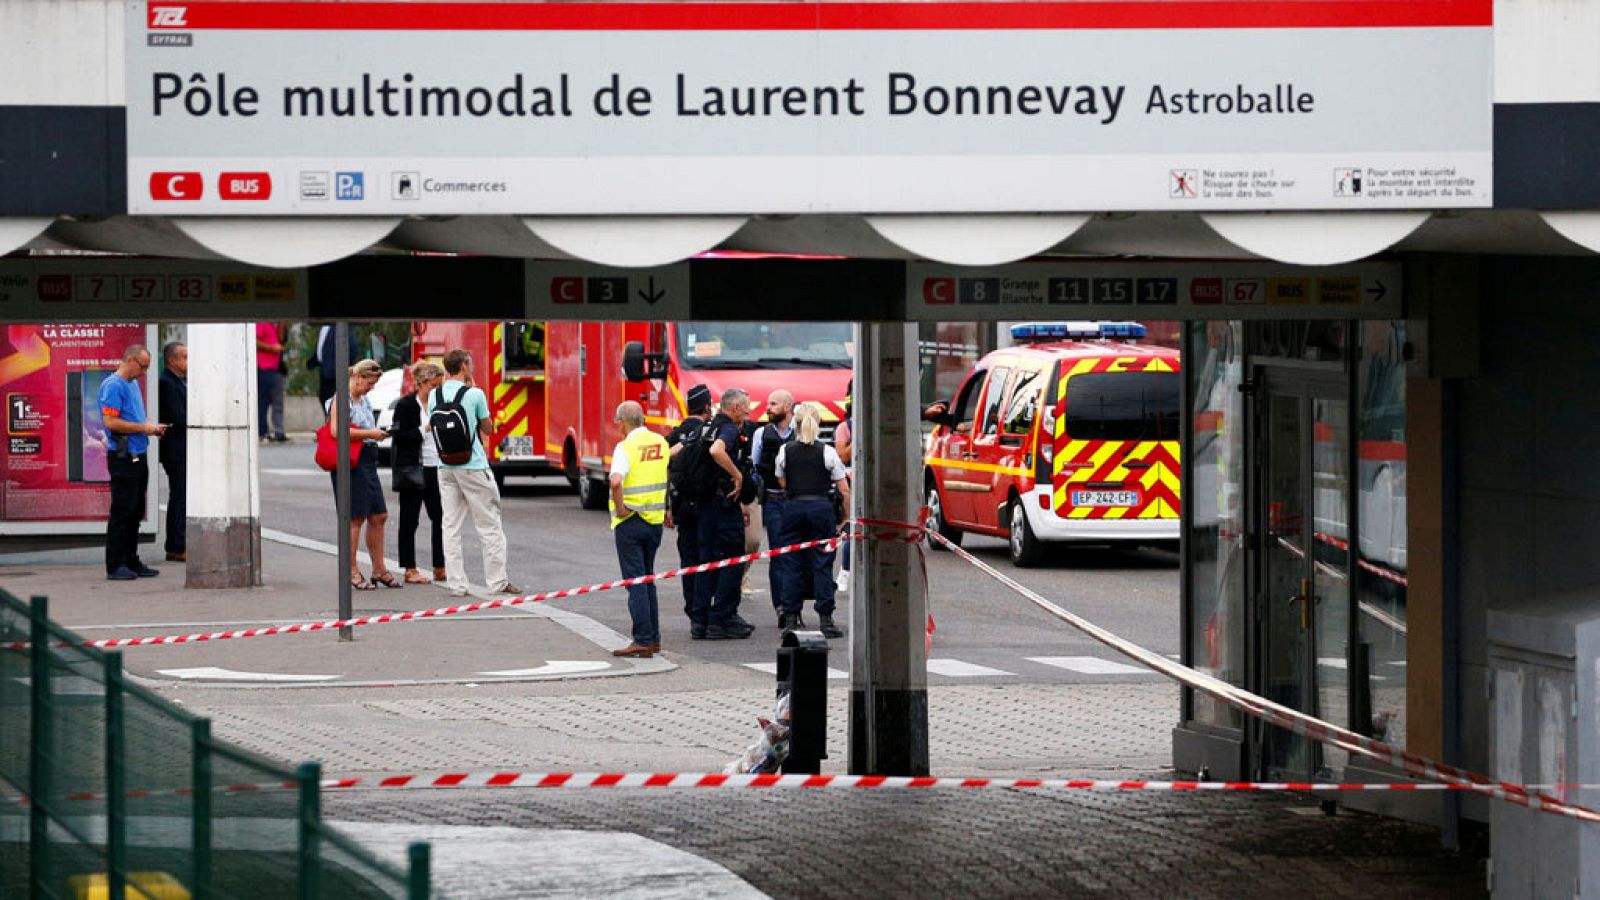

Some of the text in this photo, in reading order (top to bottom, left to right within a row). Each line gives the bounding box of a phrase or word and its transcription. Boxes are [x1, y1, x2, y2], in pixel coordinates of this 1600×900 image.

[152, 6, 188, 26] TCL
[152, 72, 1315, 126] Pôle multimodal de Laurent Bonnevay Astroballe
[1366, 167, 1389, 176] Pour
[167, 176, 185, 197] C
[230, 179, 260, 193] BUS
[423, 177, 507, 192] Commerces
[1203, 179, 1234, 189] Risque
[1237, 179, 1248, 188] de
[1251, 179, 1278, 188] chute
[1434, 177, 1475, 187] interdite
[42, 280, 68, 295] BUS
[91, 279, 103, 298] 7
[131, 279, 156, 298] 57
[178, 279, 203, 298] 83
[221, 281, 247, 294] BUS
[560, 281, 576, 301] C
[601, 281, 614, 301] 3
[930, 281, 947, 301] C
[974, 281, 987, 301] 8
[1002, 278, 1040, 292] Grange
[1056, 281, 1083, 301] 11
[1100, 281, 1127, 301] 15
[1144, 281, 1169, 301] 17
[1194, 283, 1220, 298] BUS
[1233, 282, 1259, 301] 67
[1277, 283, 1303, 298] BUS
[1002, 293, 1044, 304] Blanche
[43, 329, 57, 338] LA
